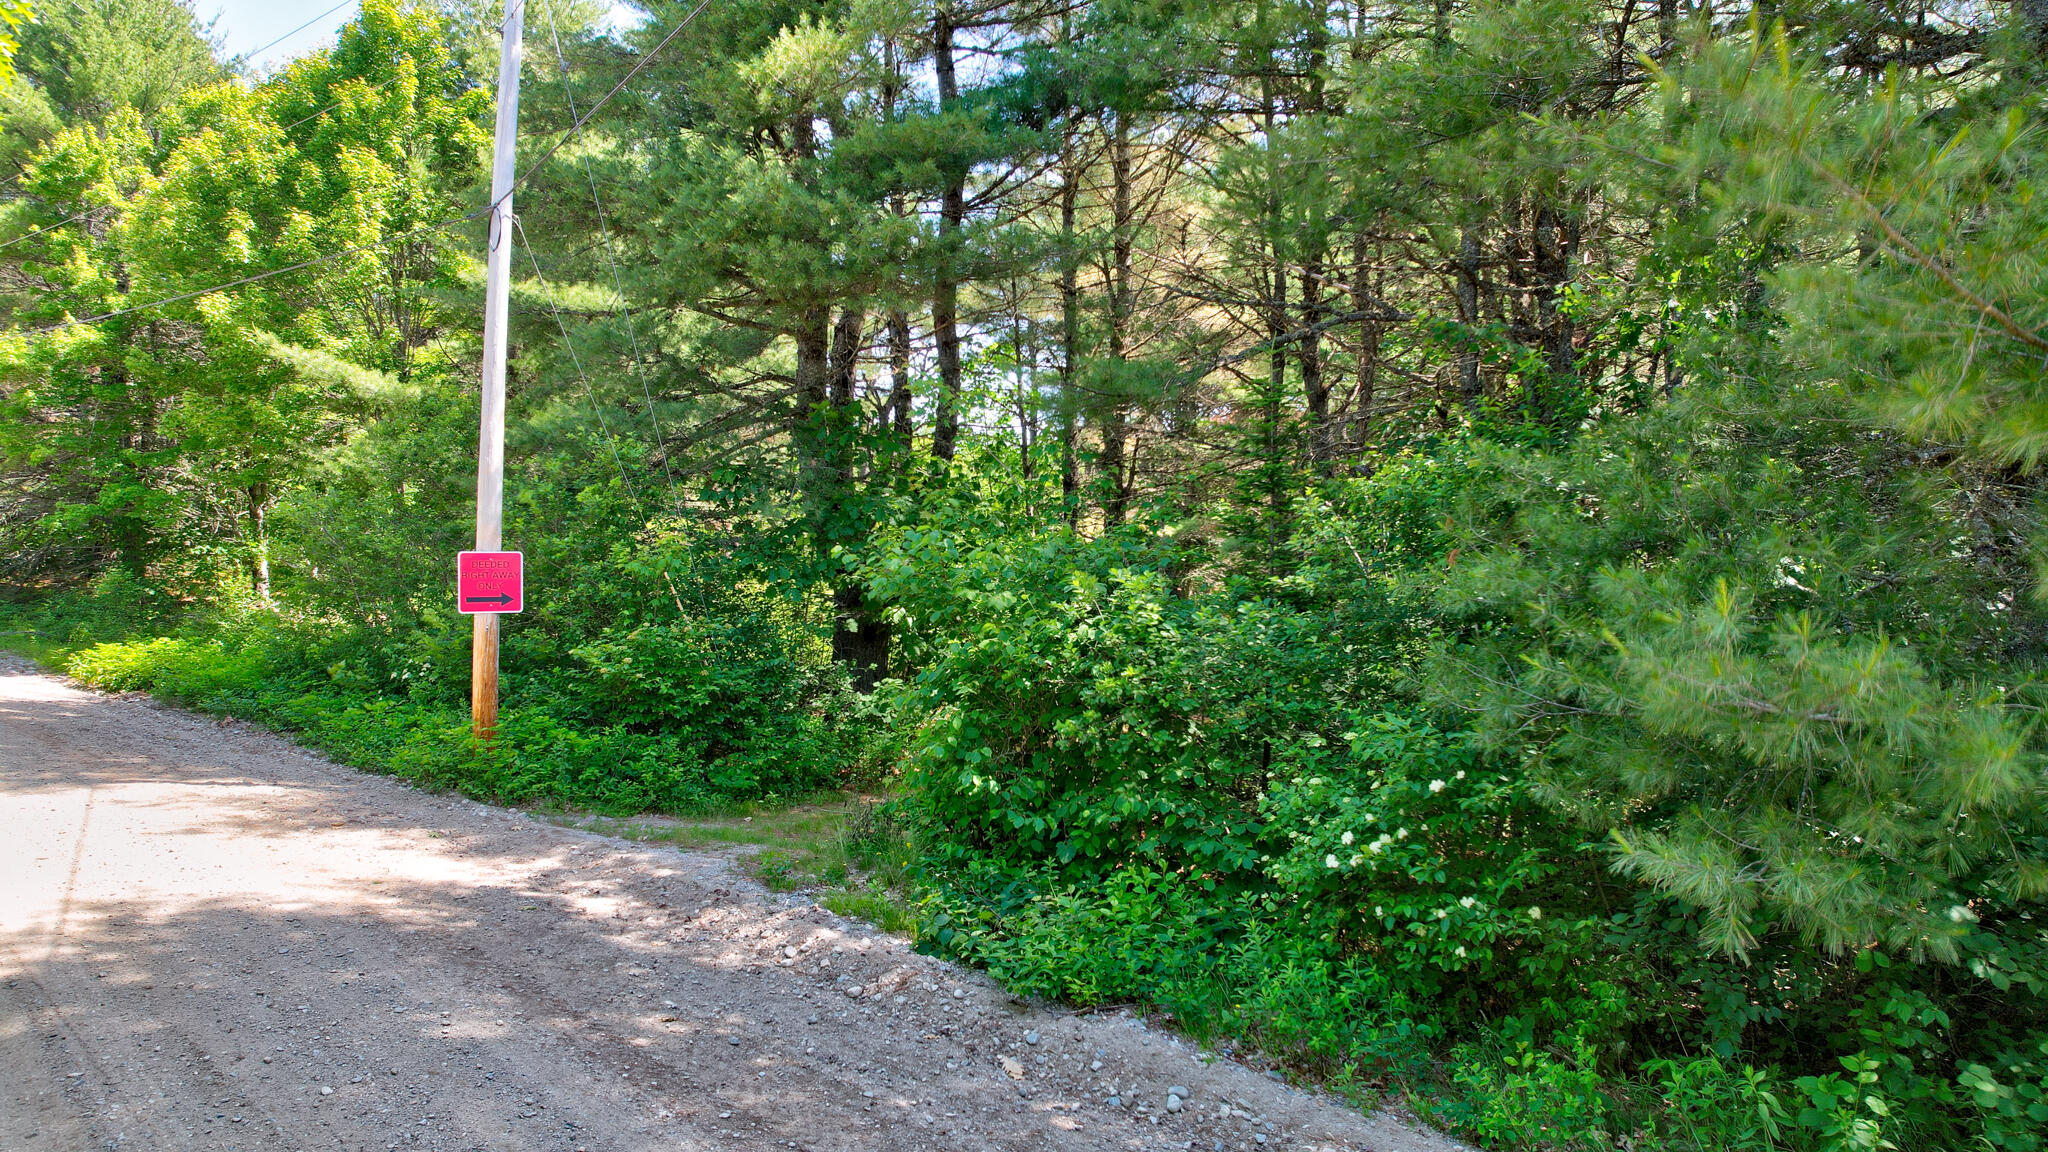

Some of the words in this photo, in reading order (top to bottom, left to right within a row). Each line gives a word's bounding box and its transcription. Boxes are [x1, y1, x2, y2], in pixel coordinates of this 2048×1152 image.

[462, 571, 489, 579] RIGHT
[493, 571, 519, 579] AWAY
[478, 582, 503, 590] ONLY
